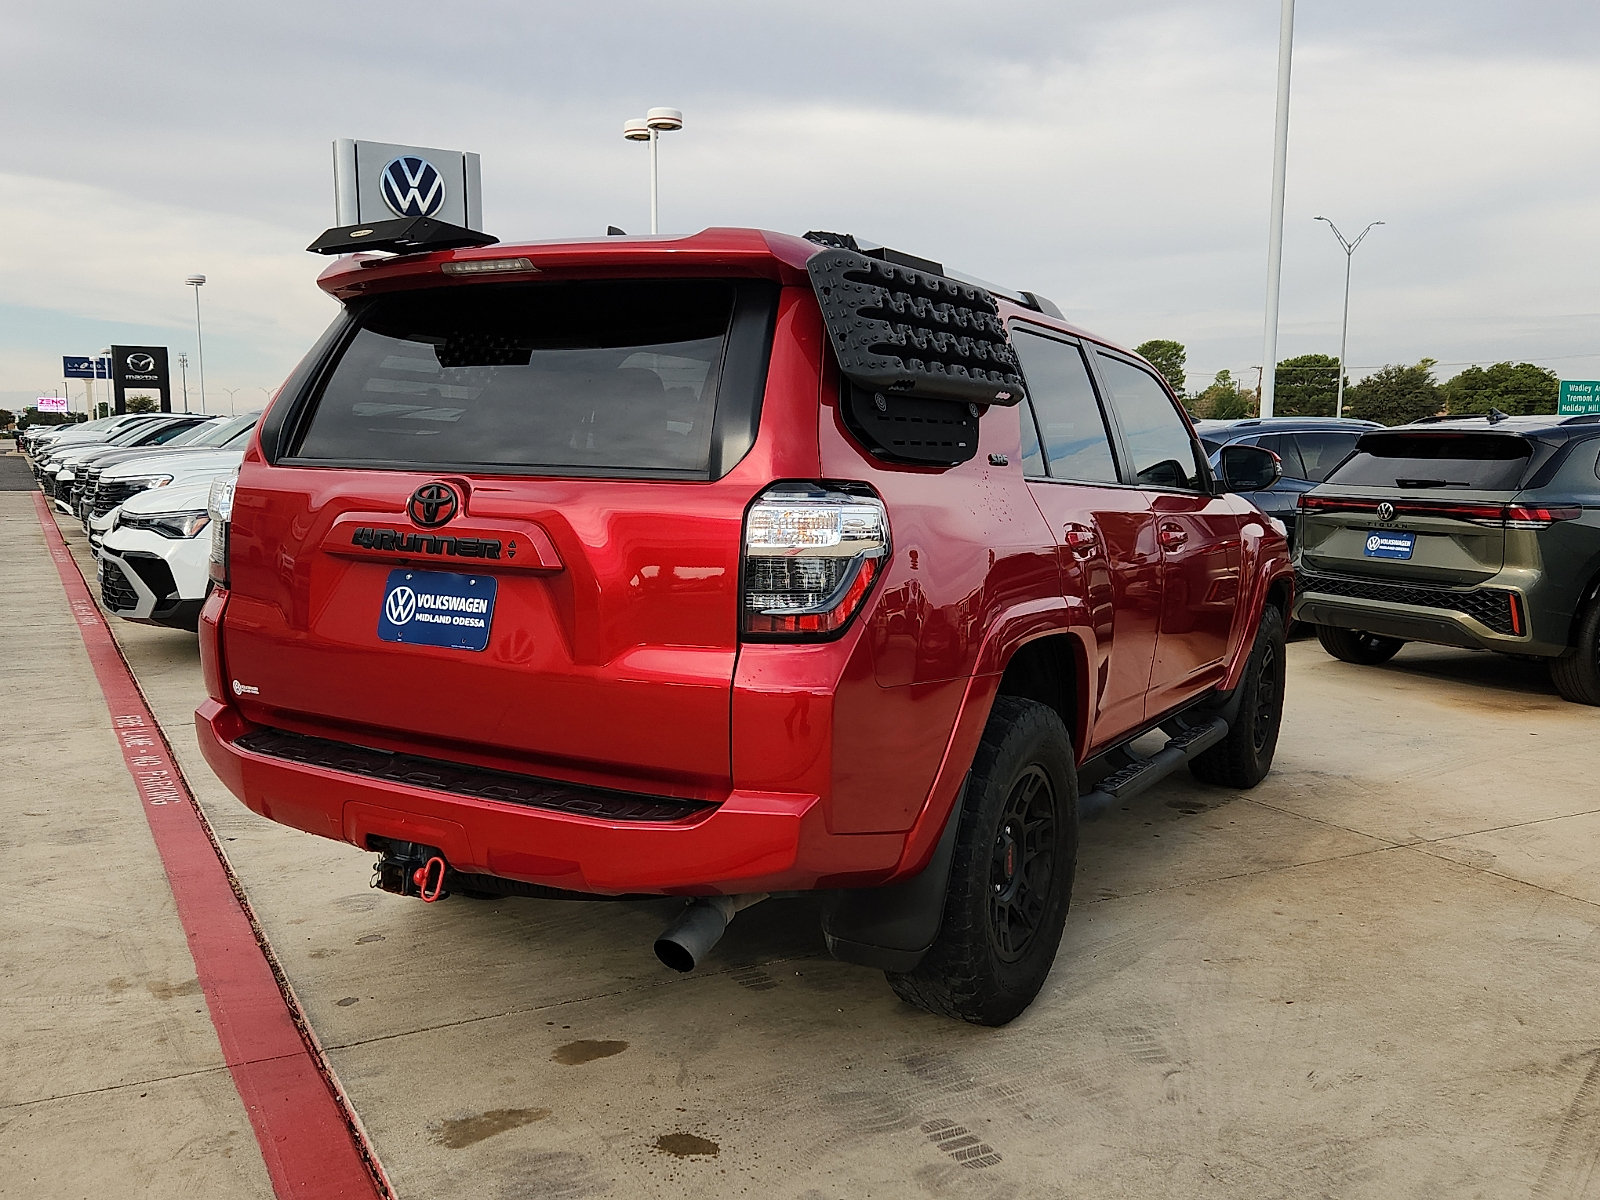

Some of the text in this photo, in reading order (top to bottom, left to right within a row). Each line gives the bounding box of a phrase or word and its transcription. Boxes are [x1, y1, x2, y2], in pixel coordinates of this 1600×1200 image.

[1569, 384, 1592, 393] Wadley
[39, 398, 65, 406] ZENO
[1566, 394, 1593, 402] Tremont
[1562, 404, 1599, 413] Holiday Hill
[1367, 521, 1408, 529] TIGUAN
[417, 593, 488, 613] VOLKSWAGEN
[415, 613, 485, 628] MIDLAND ODESSA
[130, 755, 163, 767] NO
[137, 769, 181, 805] PARKING
